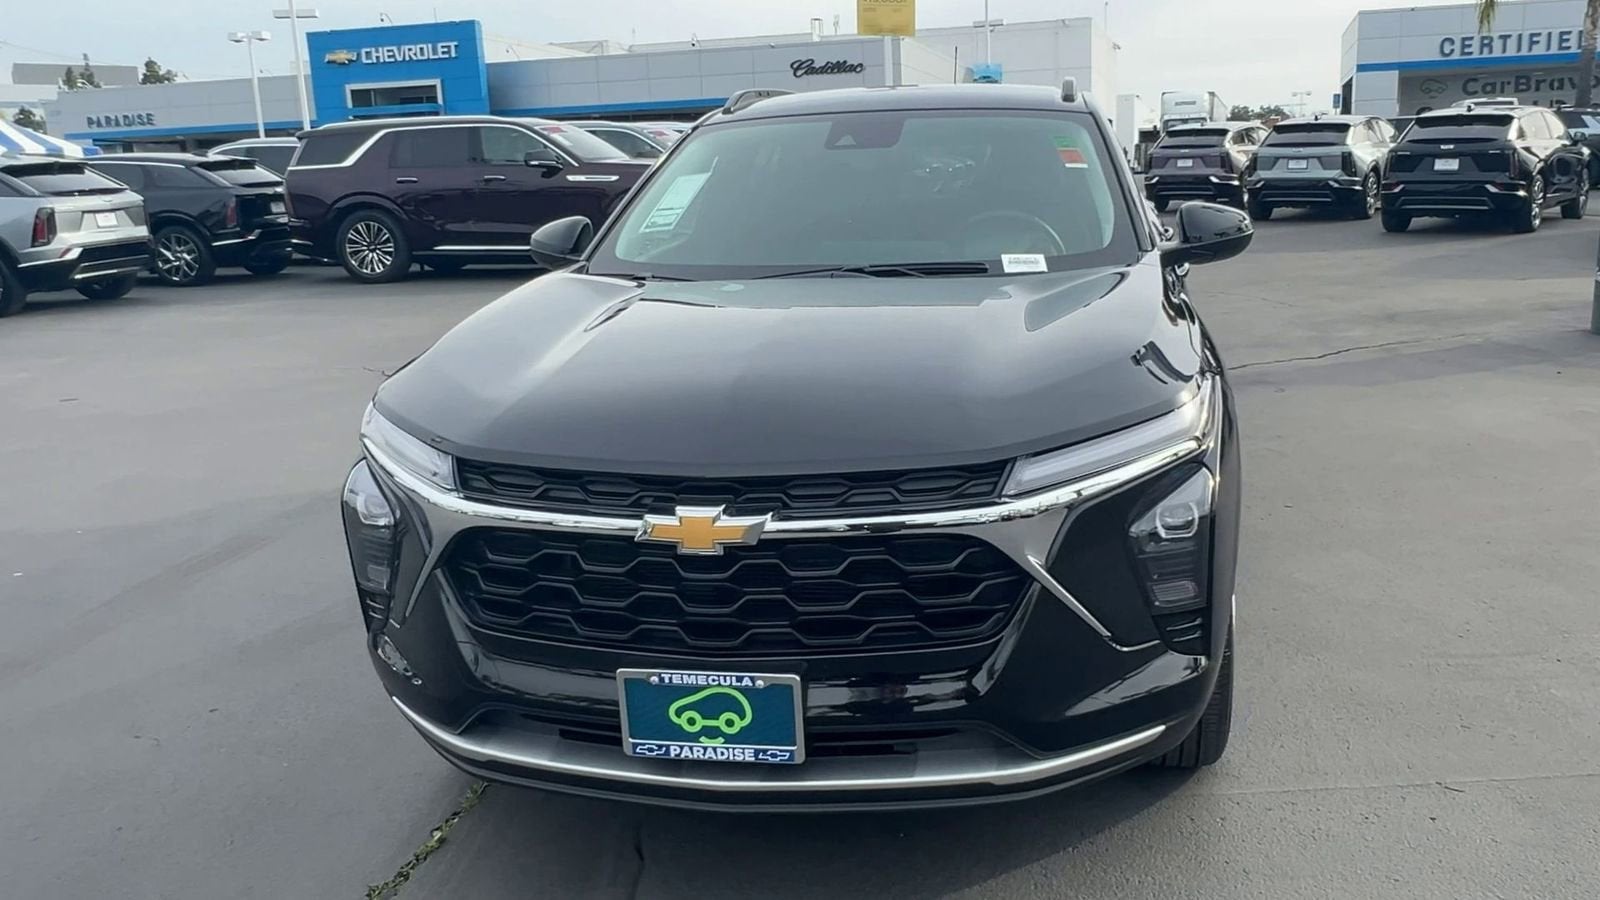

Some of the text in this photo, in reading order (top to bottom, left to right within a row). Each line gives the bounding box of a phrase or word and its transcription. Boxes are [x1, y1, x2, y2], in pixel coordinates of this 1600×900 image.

[1439, 29, 1584, 57] CERTIFIE
[361, 41, 458, 64] CHEVROLET
[790, 58, 866, 78] Cadillac
[86, 112, 156, 129] PARADISE
[661, 673, 753, 687] TEMECULA
[670, 745, 755, 761] PARADISE
